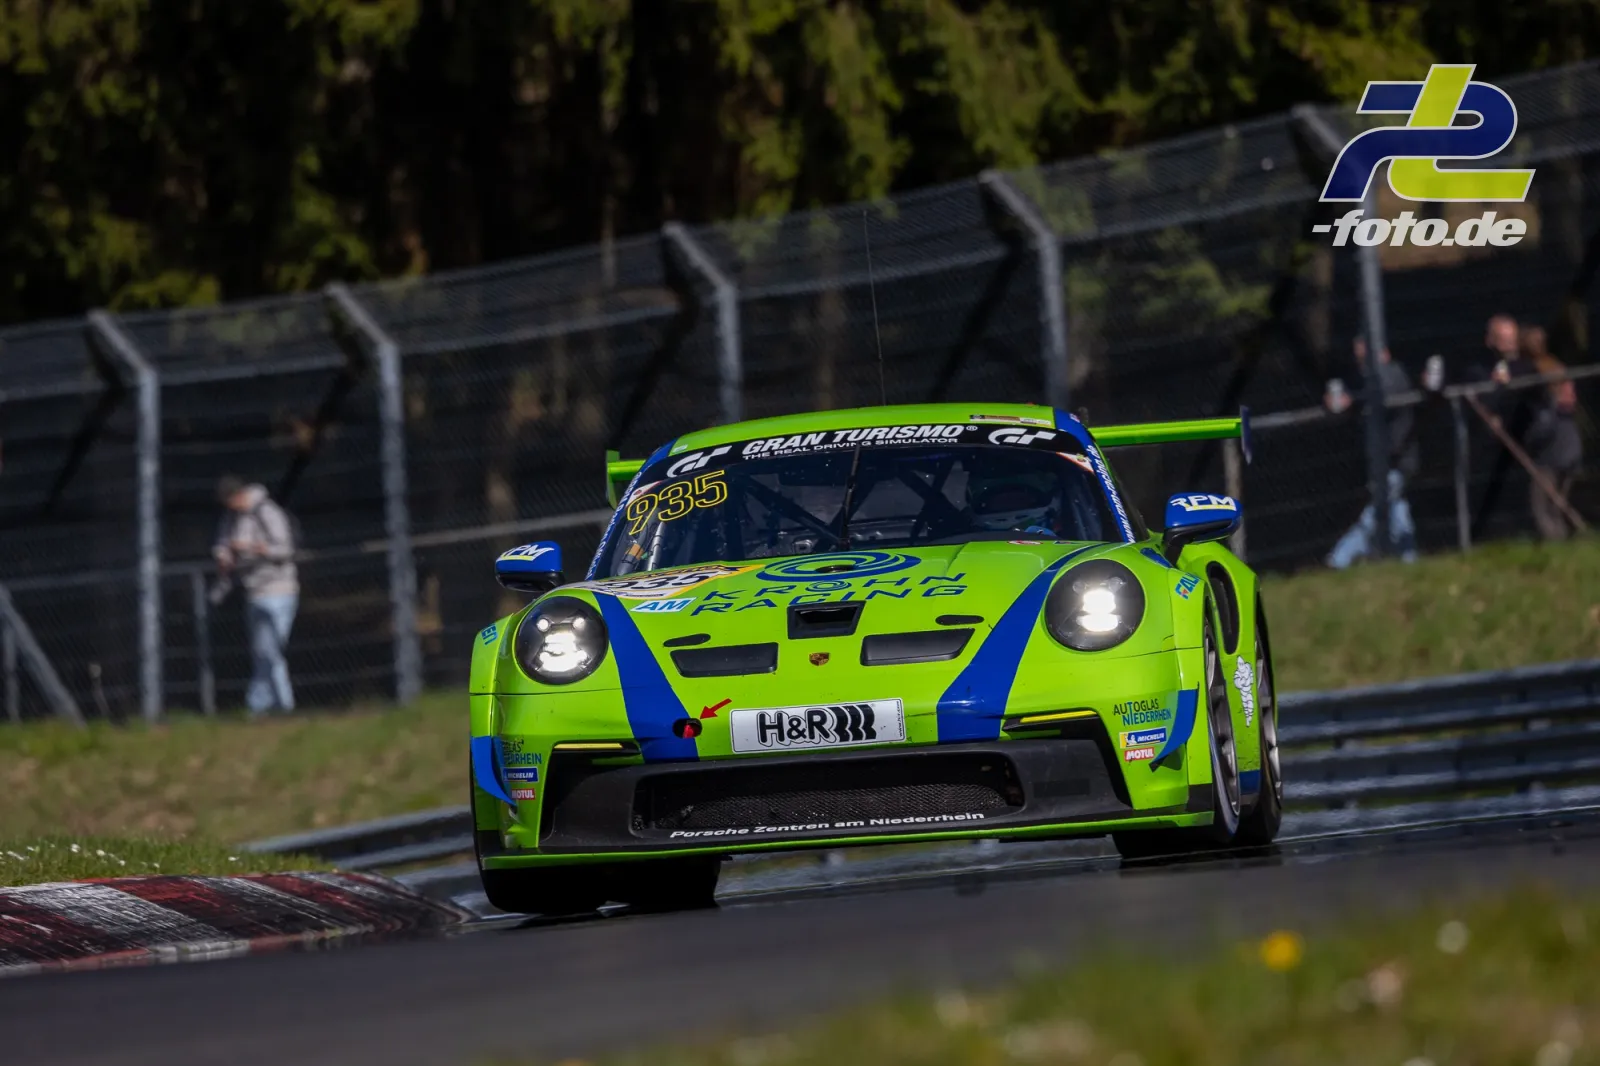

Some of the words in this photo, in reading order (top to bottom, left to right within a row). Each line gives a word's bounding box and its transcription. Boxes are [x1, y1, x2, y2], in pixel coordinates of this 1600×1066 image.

[742, 432, 827, 455] GRAN
[742, 451, 771, 461] THE
[774, 445, 811, 456] REAL
[875, 437, 958, 446] SIMULATOR
[626, 469, 728, 536] 935
[635, 600, 690, 612] AM
[690, 585, 968, 617] RACING
[1113, 698, 1160, 716] AUTOGLAS
[1137, 732, 1165, 742] MICHELIN
[1126, 748, 1154, 761] MOTUL
[670, 828, 749, 838] Porsche
[753, 822, 829, 833] Zentren
[834, 820, 865, 828] am
[870, 812, 985, 826] Niederrhein
